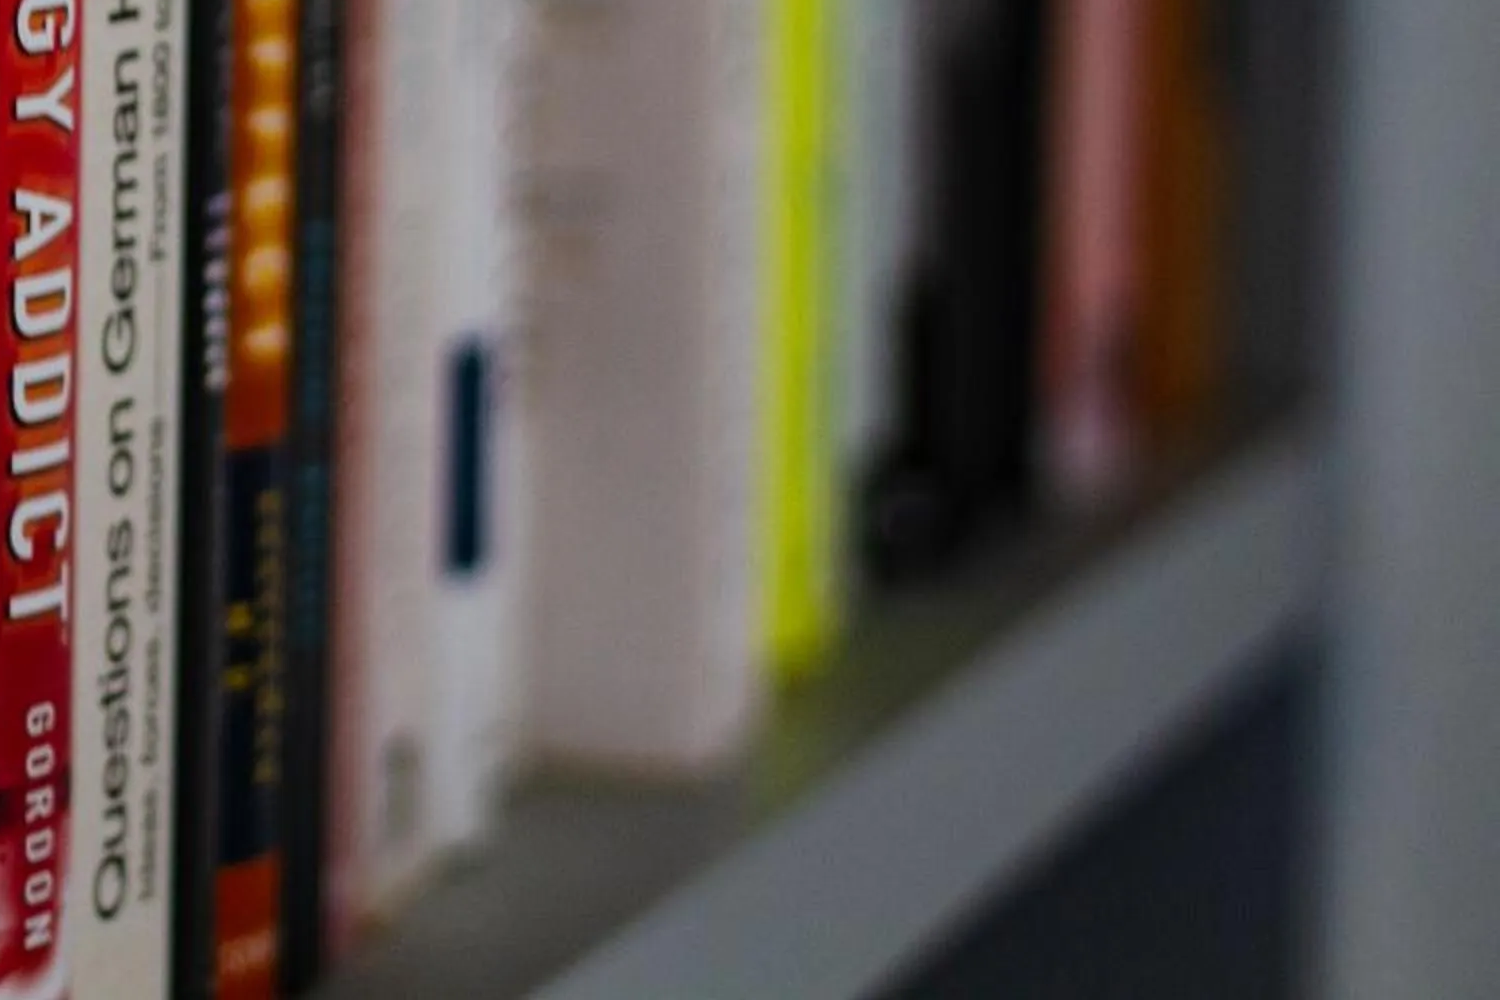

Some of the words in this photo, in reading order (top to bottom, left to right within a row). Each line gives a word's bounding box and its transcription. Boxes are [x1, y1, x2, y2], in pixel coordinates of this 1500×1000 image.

[101, 48, 141, 375] German
[8, 188, 72, 620] ADDICT
[108, 397, 135, 497] on
[24, 700, 55, 951] GORDON
[94, 516, 134, 920] Questions
